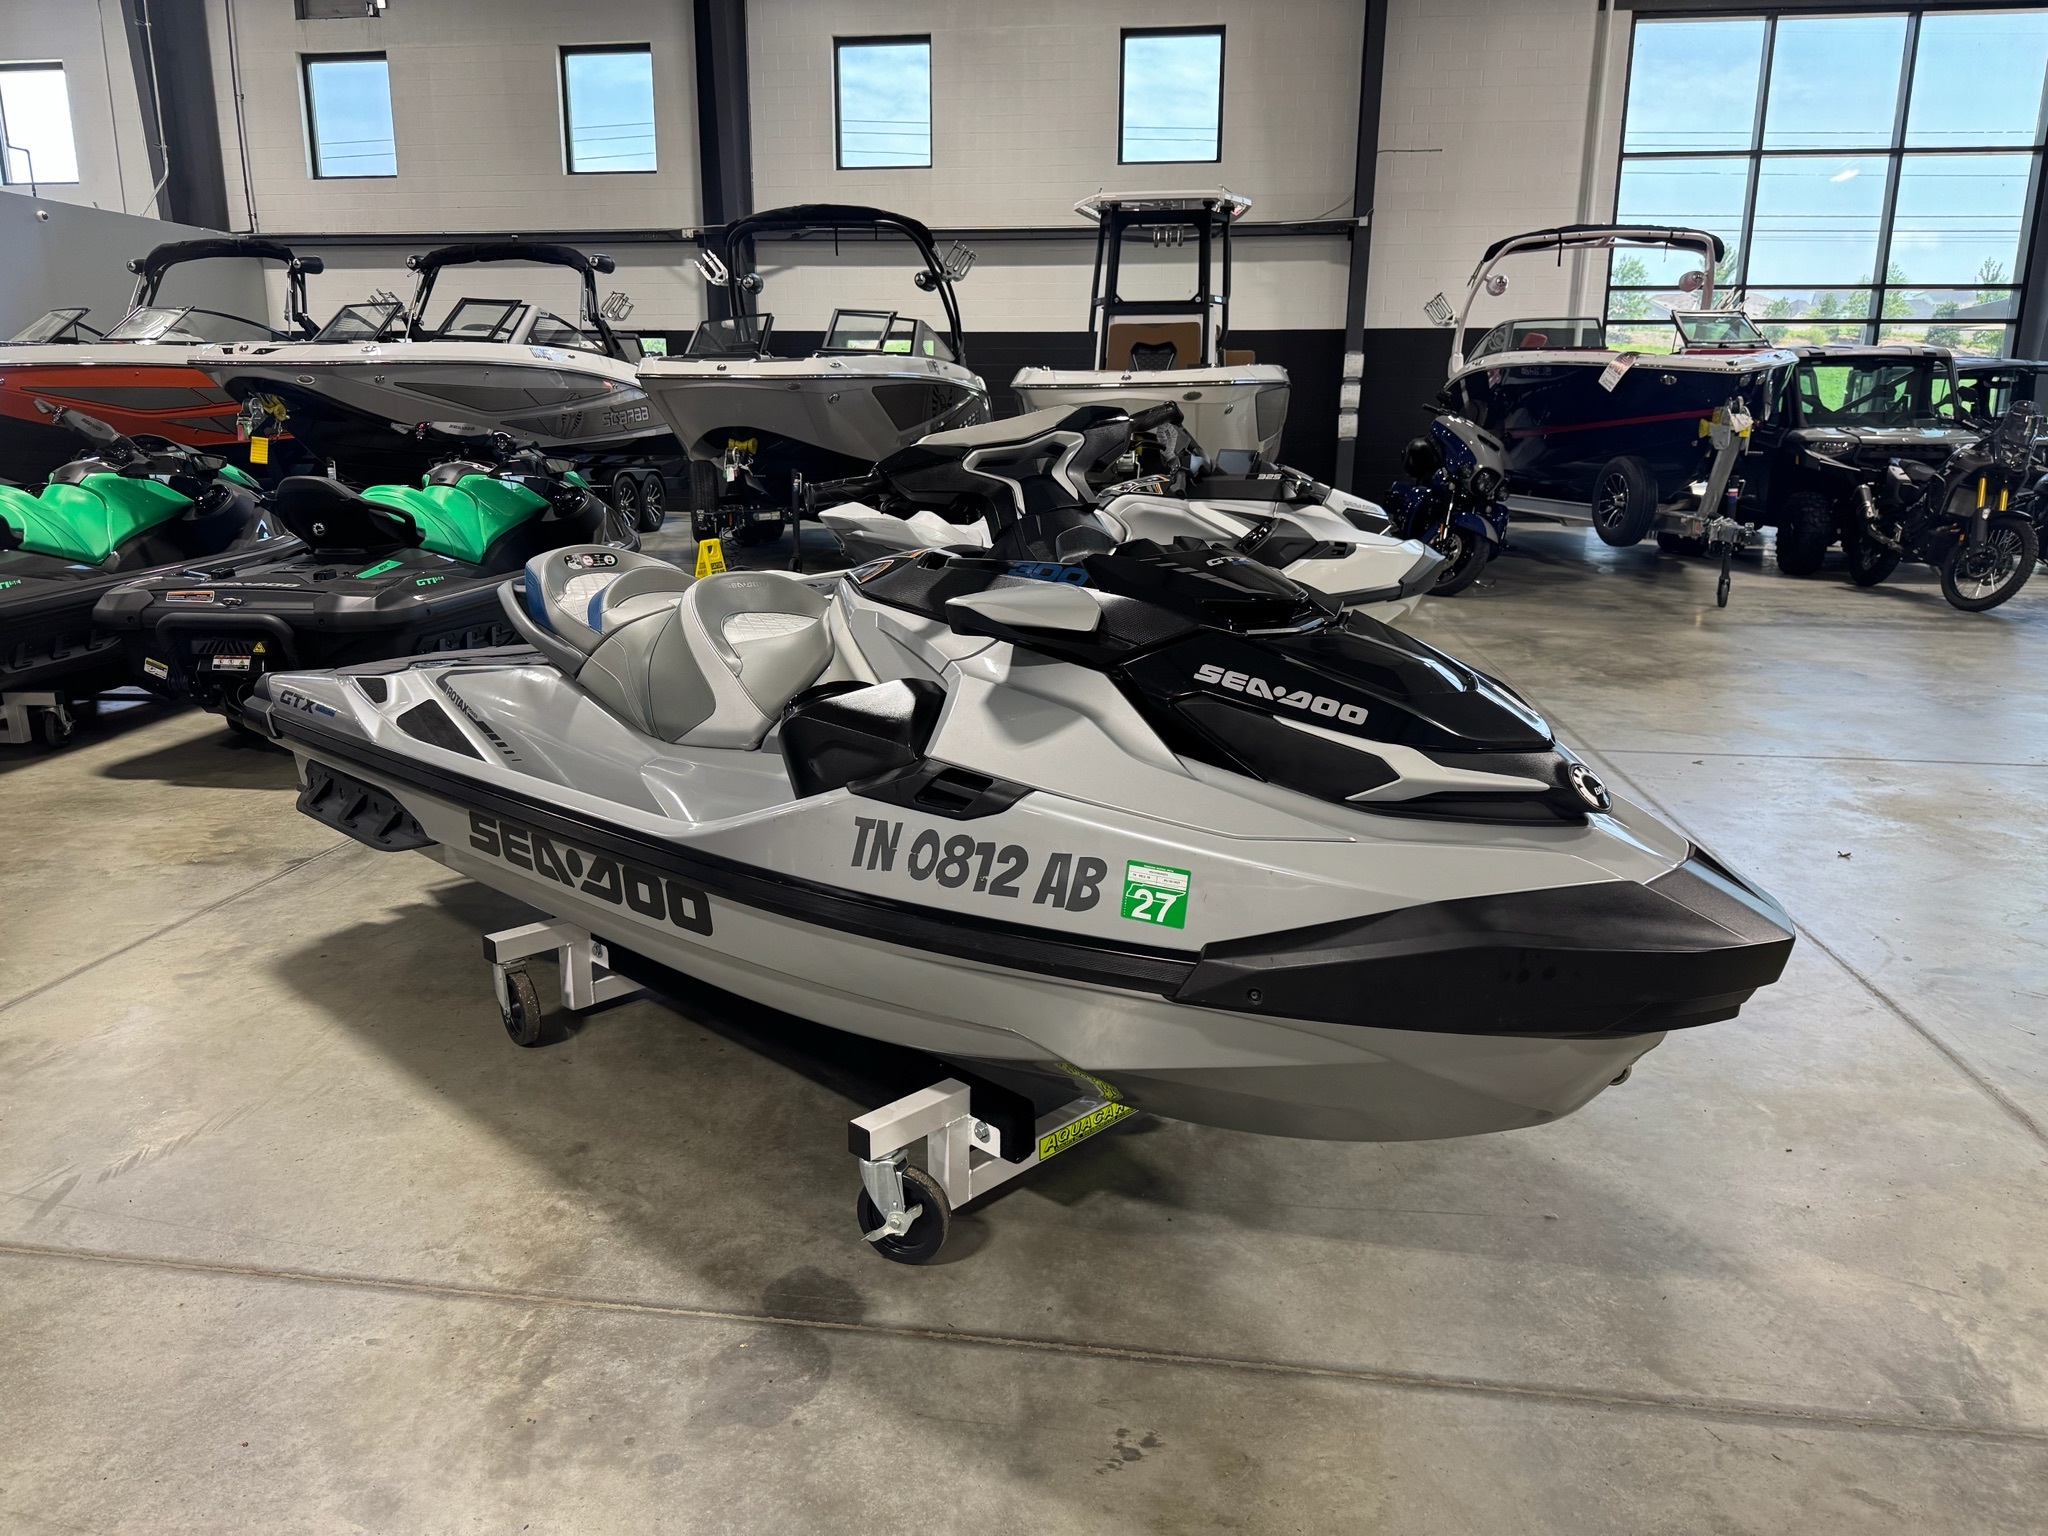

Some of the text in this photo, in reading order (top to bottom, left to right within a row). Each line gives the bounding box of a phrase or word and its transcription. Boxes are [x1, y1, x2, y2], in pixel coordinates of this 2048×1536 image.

[1007, 561, 1090, 587] 300
[280, 689, 316, 715] GTX
[445, 686, 470, 715] ROTAX
[850, 815, 1108, 913] TN 0812 AB
[1131, 888, 1177, 923] 27
